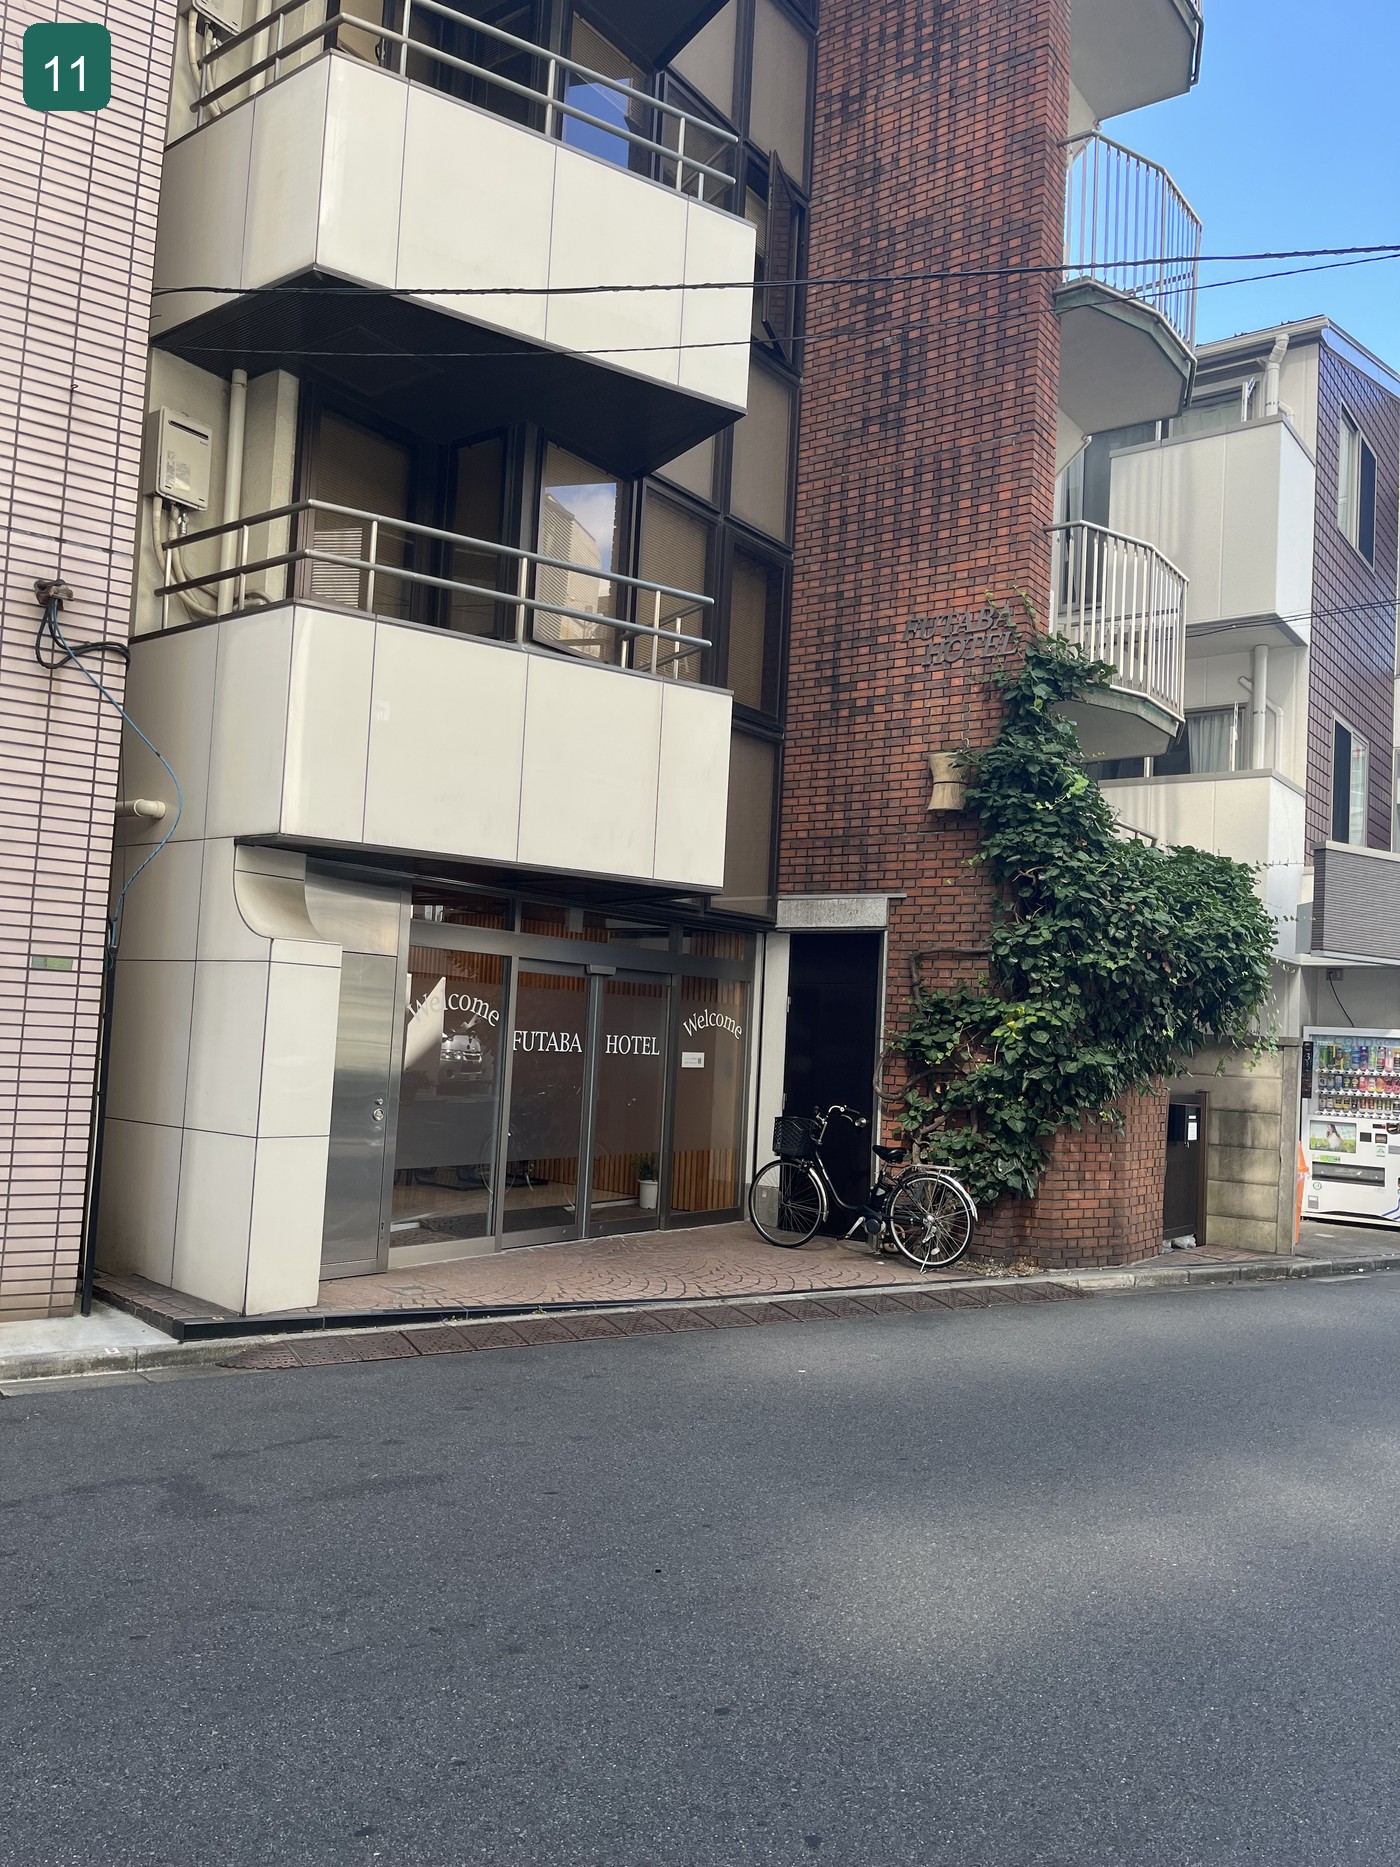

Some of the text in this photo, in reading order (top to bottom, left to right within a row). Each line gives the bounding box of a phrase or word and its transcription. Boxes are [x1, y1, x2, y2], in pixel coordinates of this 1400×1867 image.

[900, 600, 1017, 642] FUTABA
[921, 631, 1018, 667] HOTEL
[406, 990, 500, 1027] Welcome
[682, 1008, 743, 1040] Welcome
[512, 1030, 660, 1056] FUTABA HOTEL
